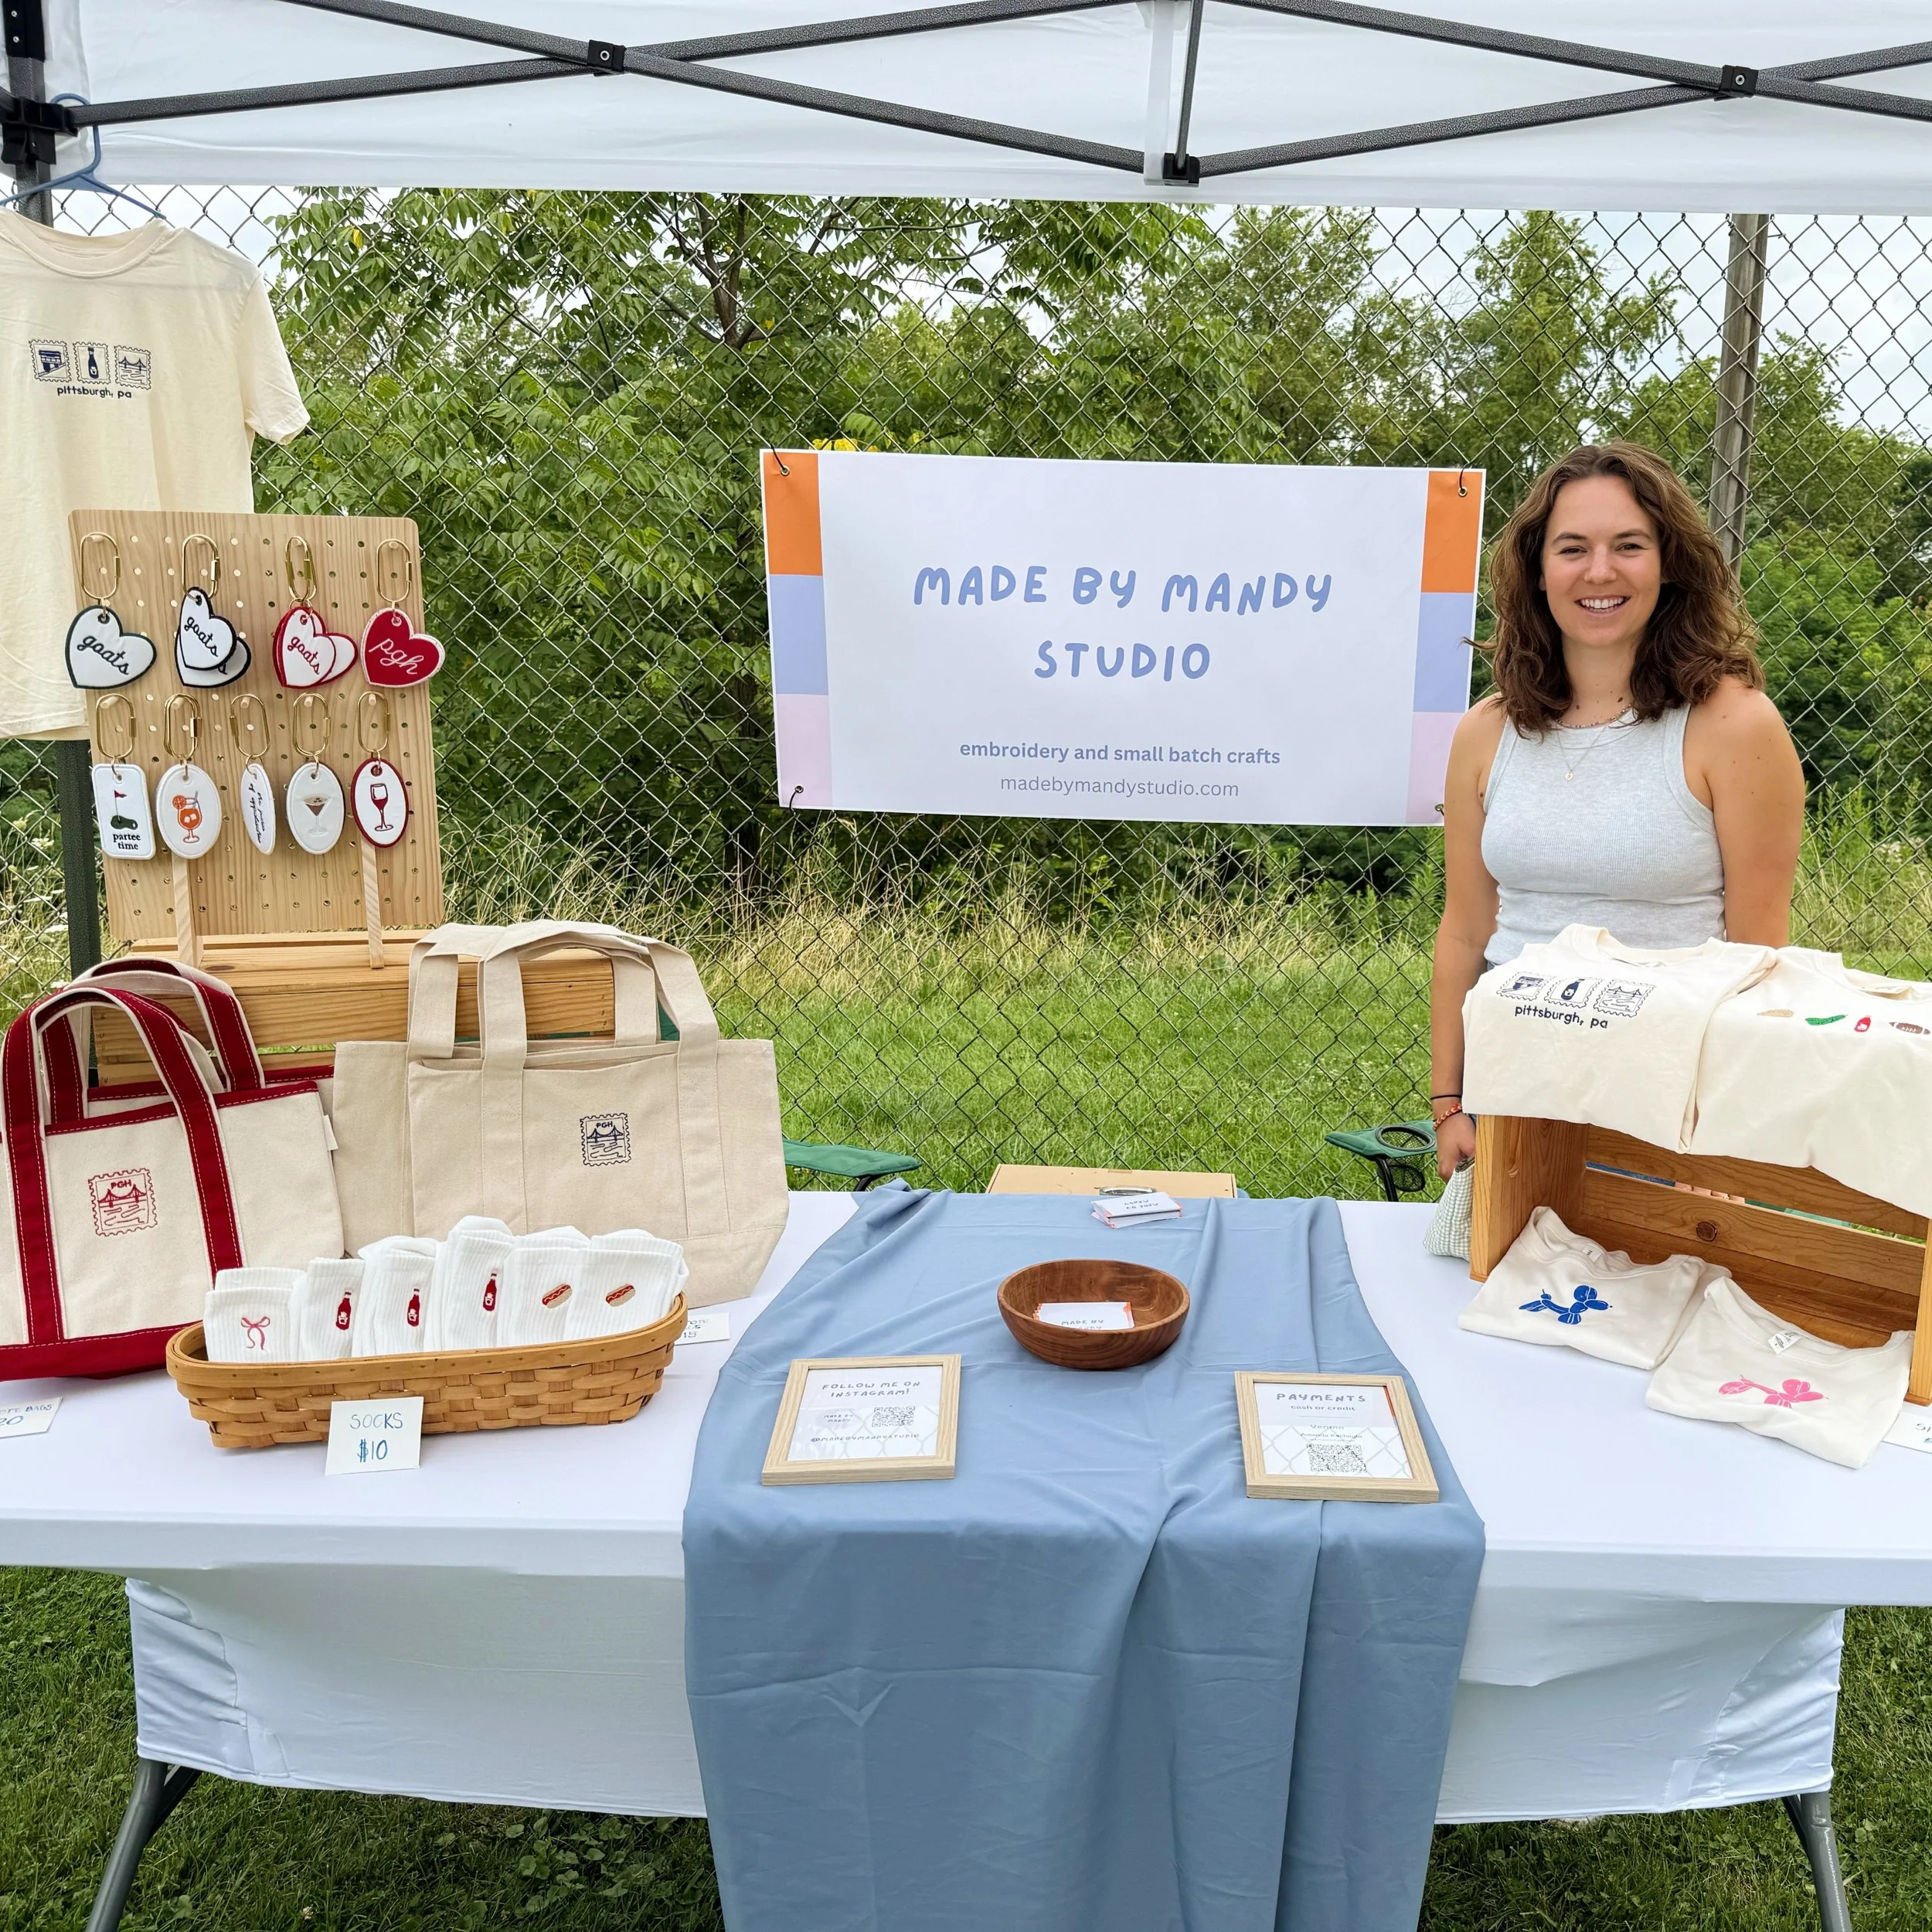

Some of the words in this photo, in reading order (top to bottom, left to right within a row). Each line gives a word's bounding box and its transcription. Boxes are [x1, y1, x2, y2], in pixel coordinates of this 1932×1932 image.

[57, 386, 114, 399] pittsburgh,
[913, 565, 1047, 605] MADE
[1072, 566, 1137, 609] BY
[1162, 573, 1332, 616] MANDY
[184, 617, 219, 657] goats
[77, 636, 130, 675] goats
[287, 637, 320, 675] goats
[369, 638, 424, 675] pgh
[1034, 641, 1210, 682] STUDIO
[960, 742, 1070, 763] embroidery
[1073, 745, 1109, 760] and
[1114, 747, 1164, 762] small
[1168, 747, 1222, 764] batch
[1226, 748, 1281, 764] crafts
[1001, 776, 1240, 798] madebymandystudio.com
[113, 833, 141, 843] partee
[117, 842, 139, 850] time
[1515, 1005, 1583, 1026] pittsburgh,
[1590, 1018, 1608, 1029] pa
[111, 1179, 132, 1189] PGH
[831, 1388, 910, 1397] INSTAGRAM!
[1276, 1393, 1366, 1402] PAYMENTS
[349, 1412, 403, 1430] SOCKS
[357, 1438, 388, 1463] $10
